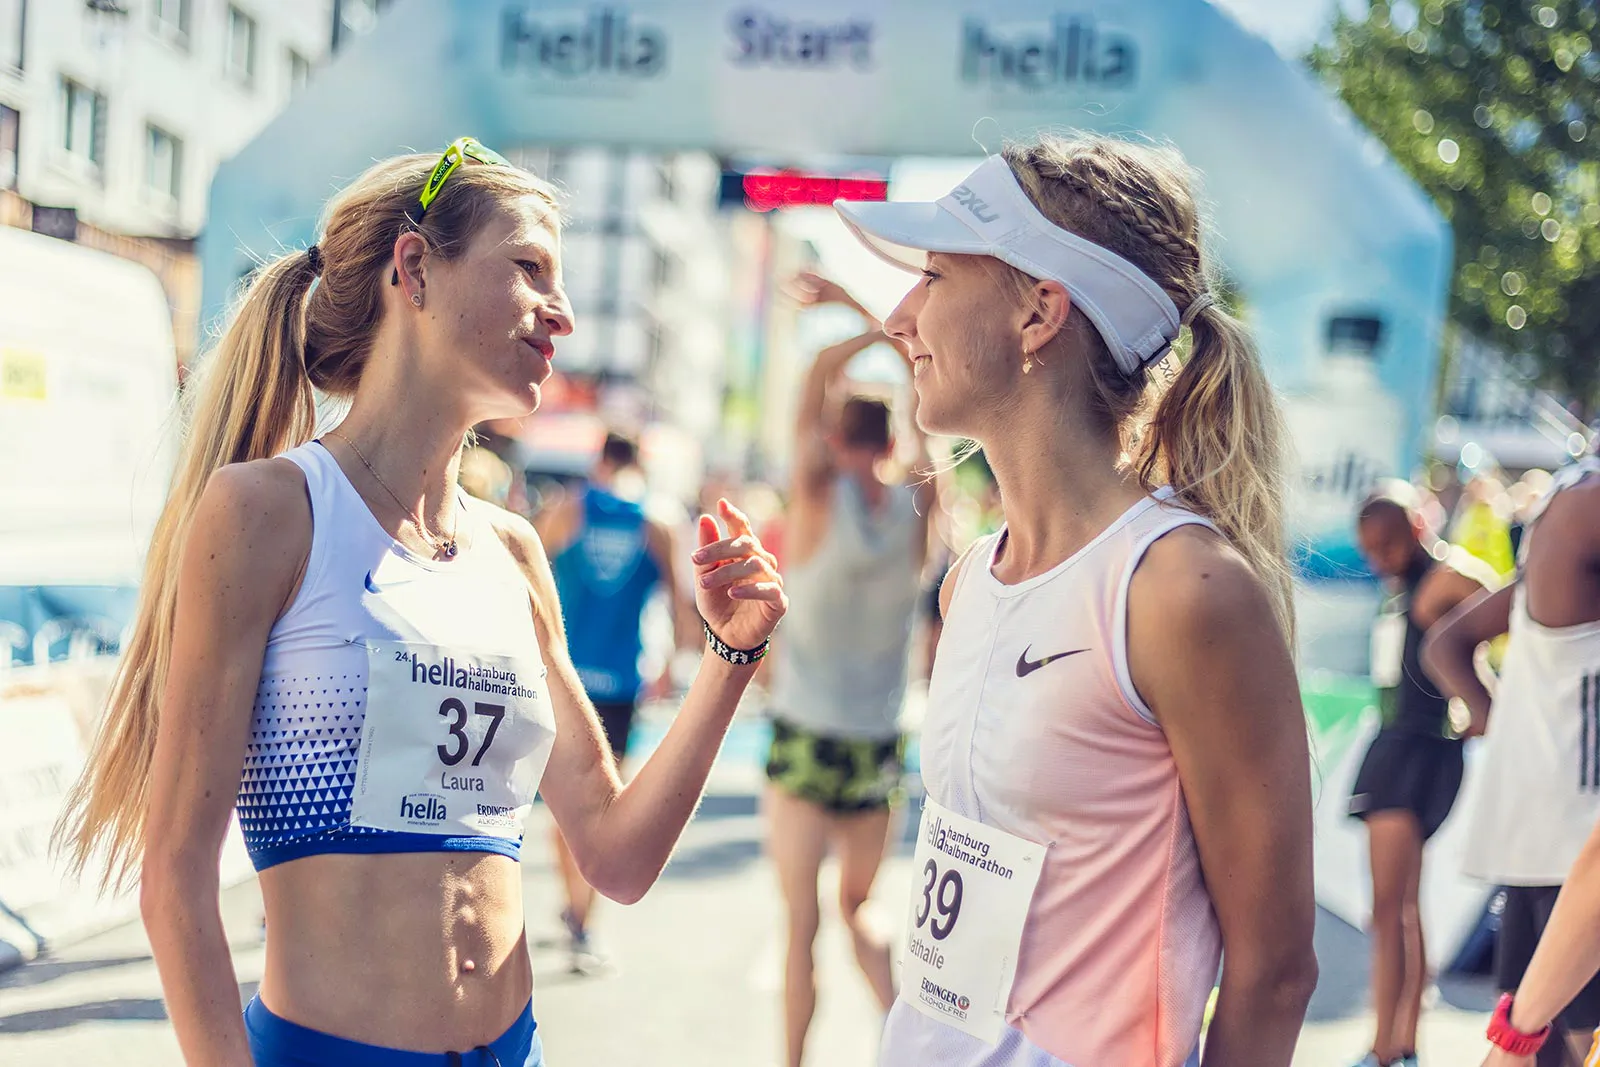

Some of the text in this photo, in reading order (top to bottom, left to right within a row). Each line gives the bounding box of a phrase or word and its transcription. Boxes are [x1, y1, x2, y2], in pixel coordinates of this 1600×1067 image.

[501, 6, 668, 78] hella
[726, 8, 876, 72] Start
[961, 15, 1141, 88] hella
[950, 185, 1000, 223] 2XU
[395, 651, 516, 689] 24. hella hamburg
[468, 677, 538, 699] halbmarathon
[437, 697, 506, 767] 37
[441, 772, 485, 792] Laura
[400, 796, 447, 820] hella
[943, 841, 1014, 880] halbmarathon
[946, 825, 990, 858] hamburg
[915, 858, 963, 941] 39
[921, 976, 958, 1006] ERDINGER
